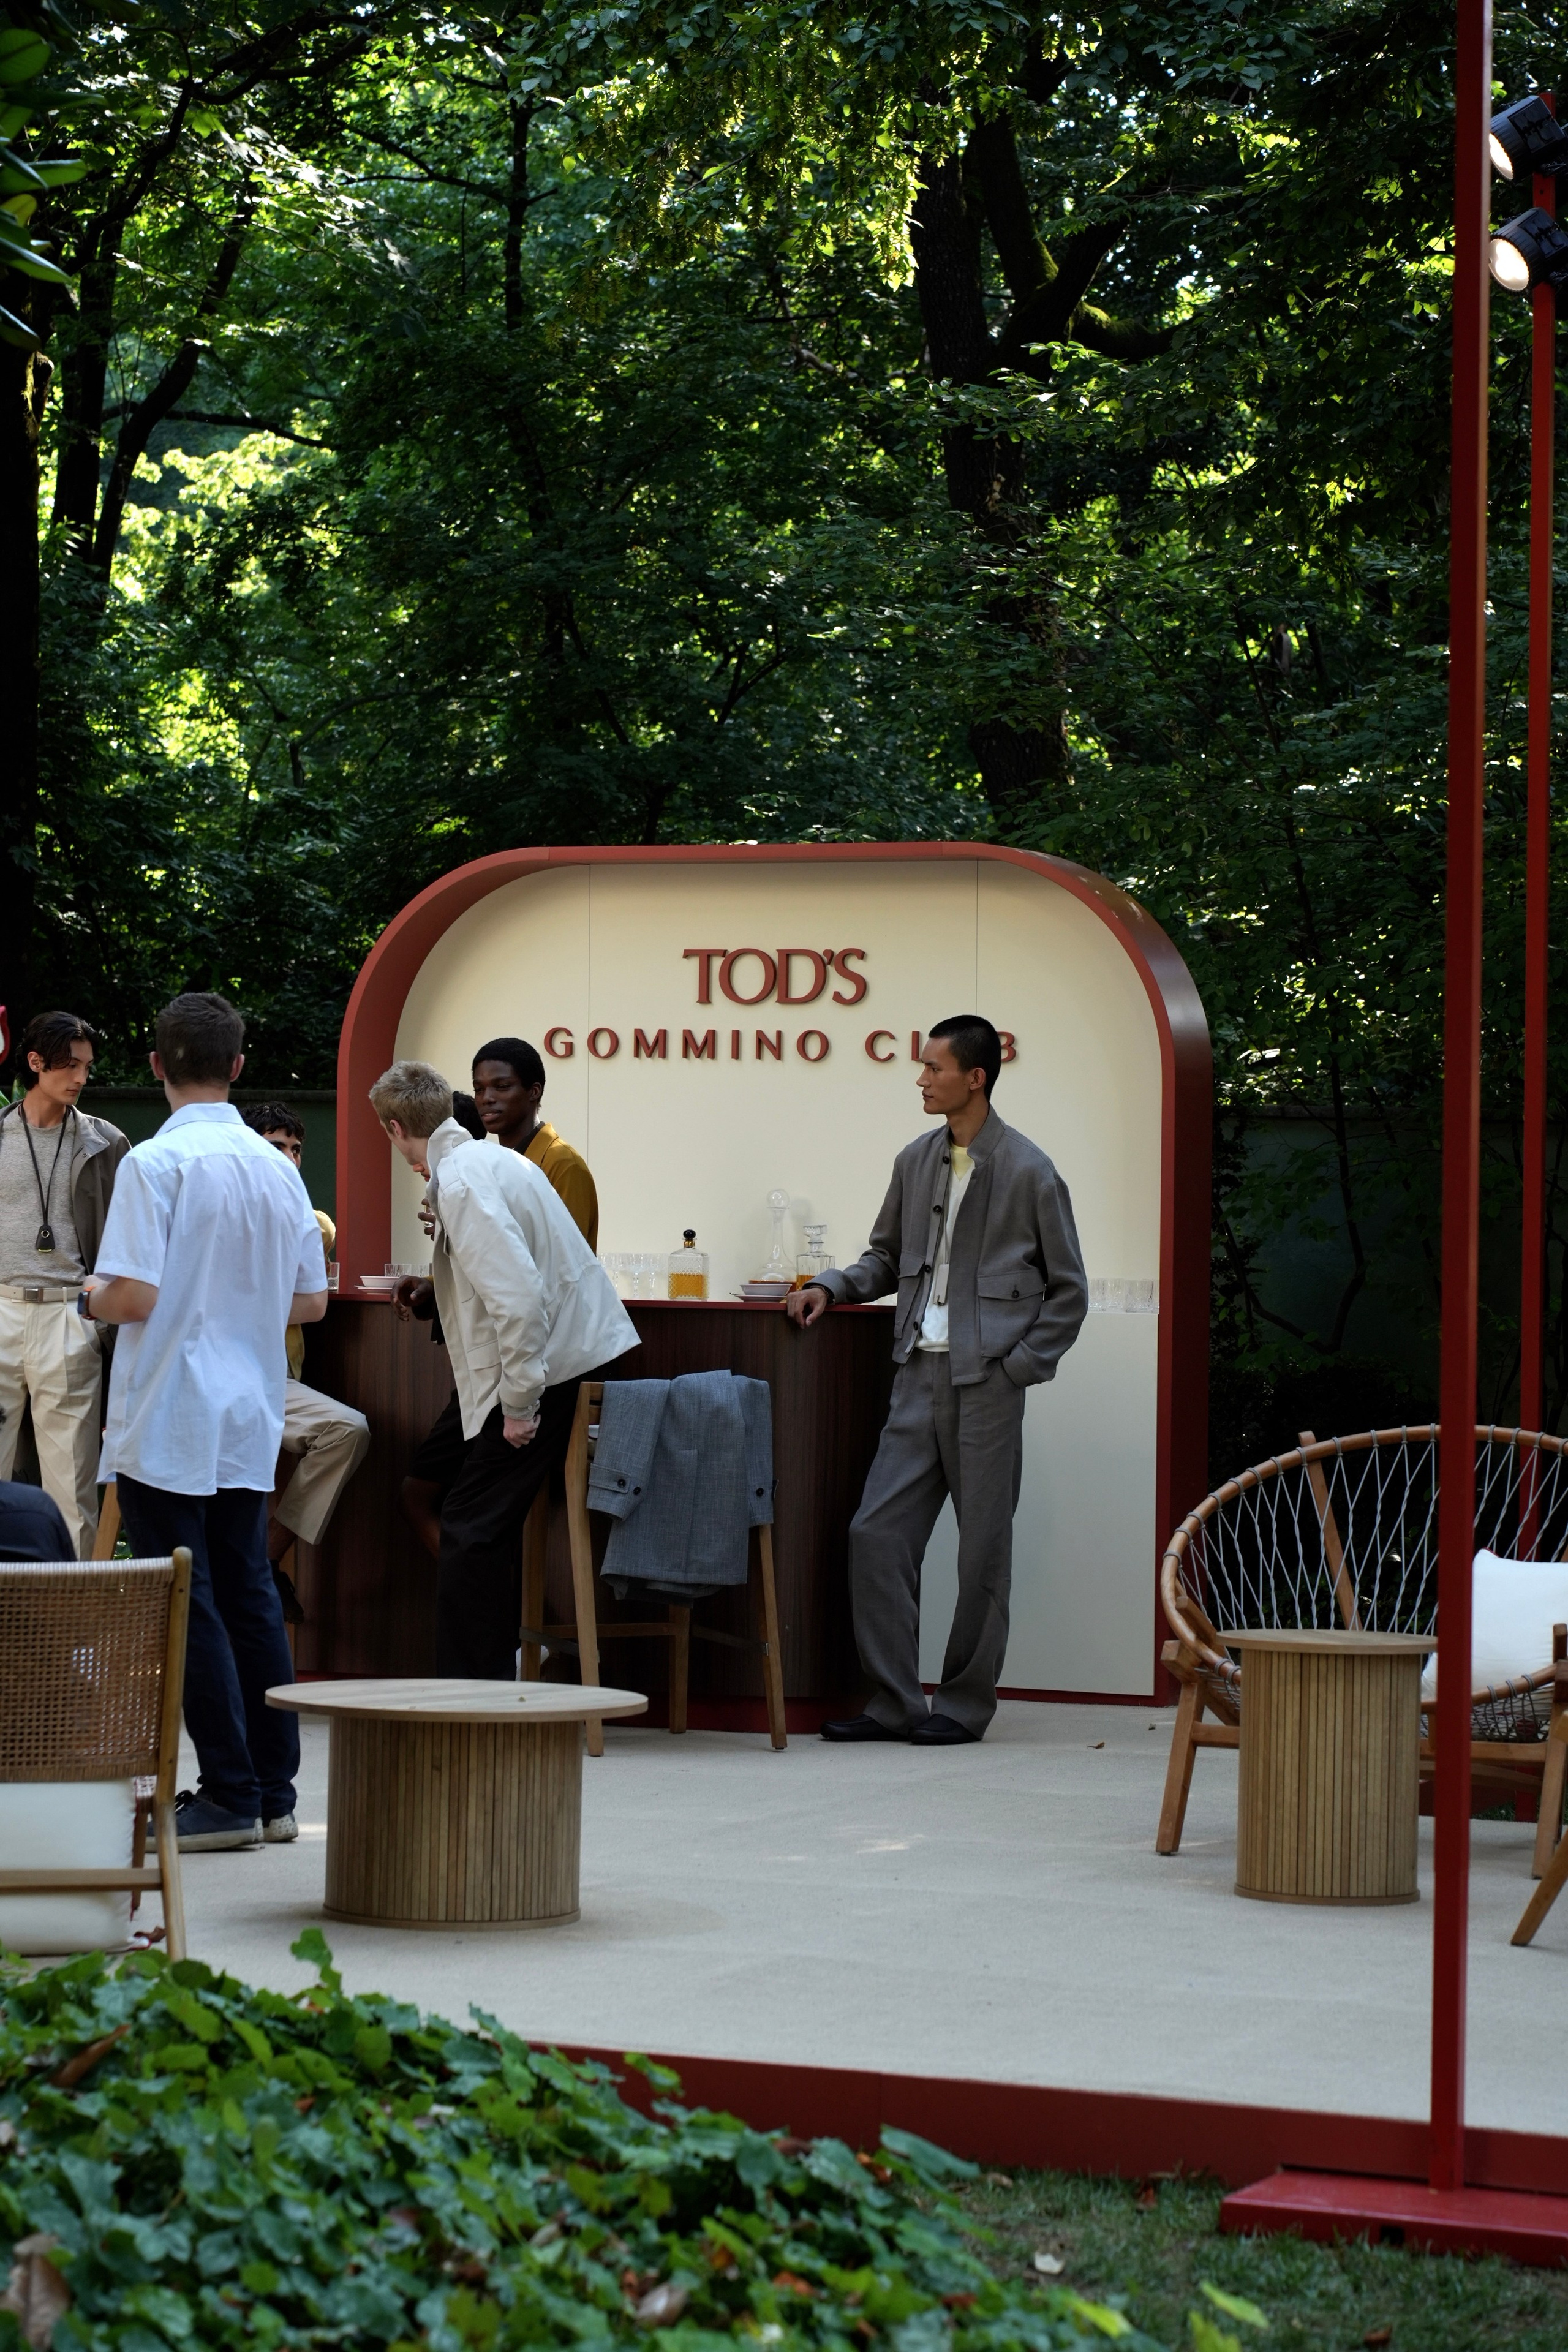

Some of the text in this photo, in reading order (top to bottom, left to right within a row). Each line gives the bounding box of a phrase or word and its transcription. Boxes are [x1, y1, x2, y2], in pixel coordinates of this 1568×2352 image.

[682, 948, 867, 1005] TOD'S
[543, 1027, 1016, 1063] GOMMINO CLB
